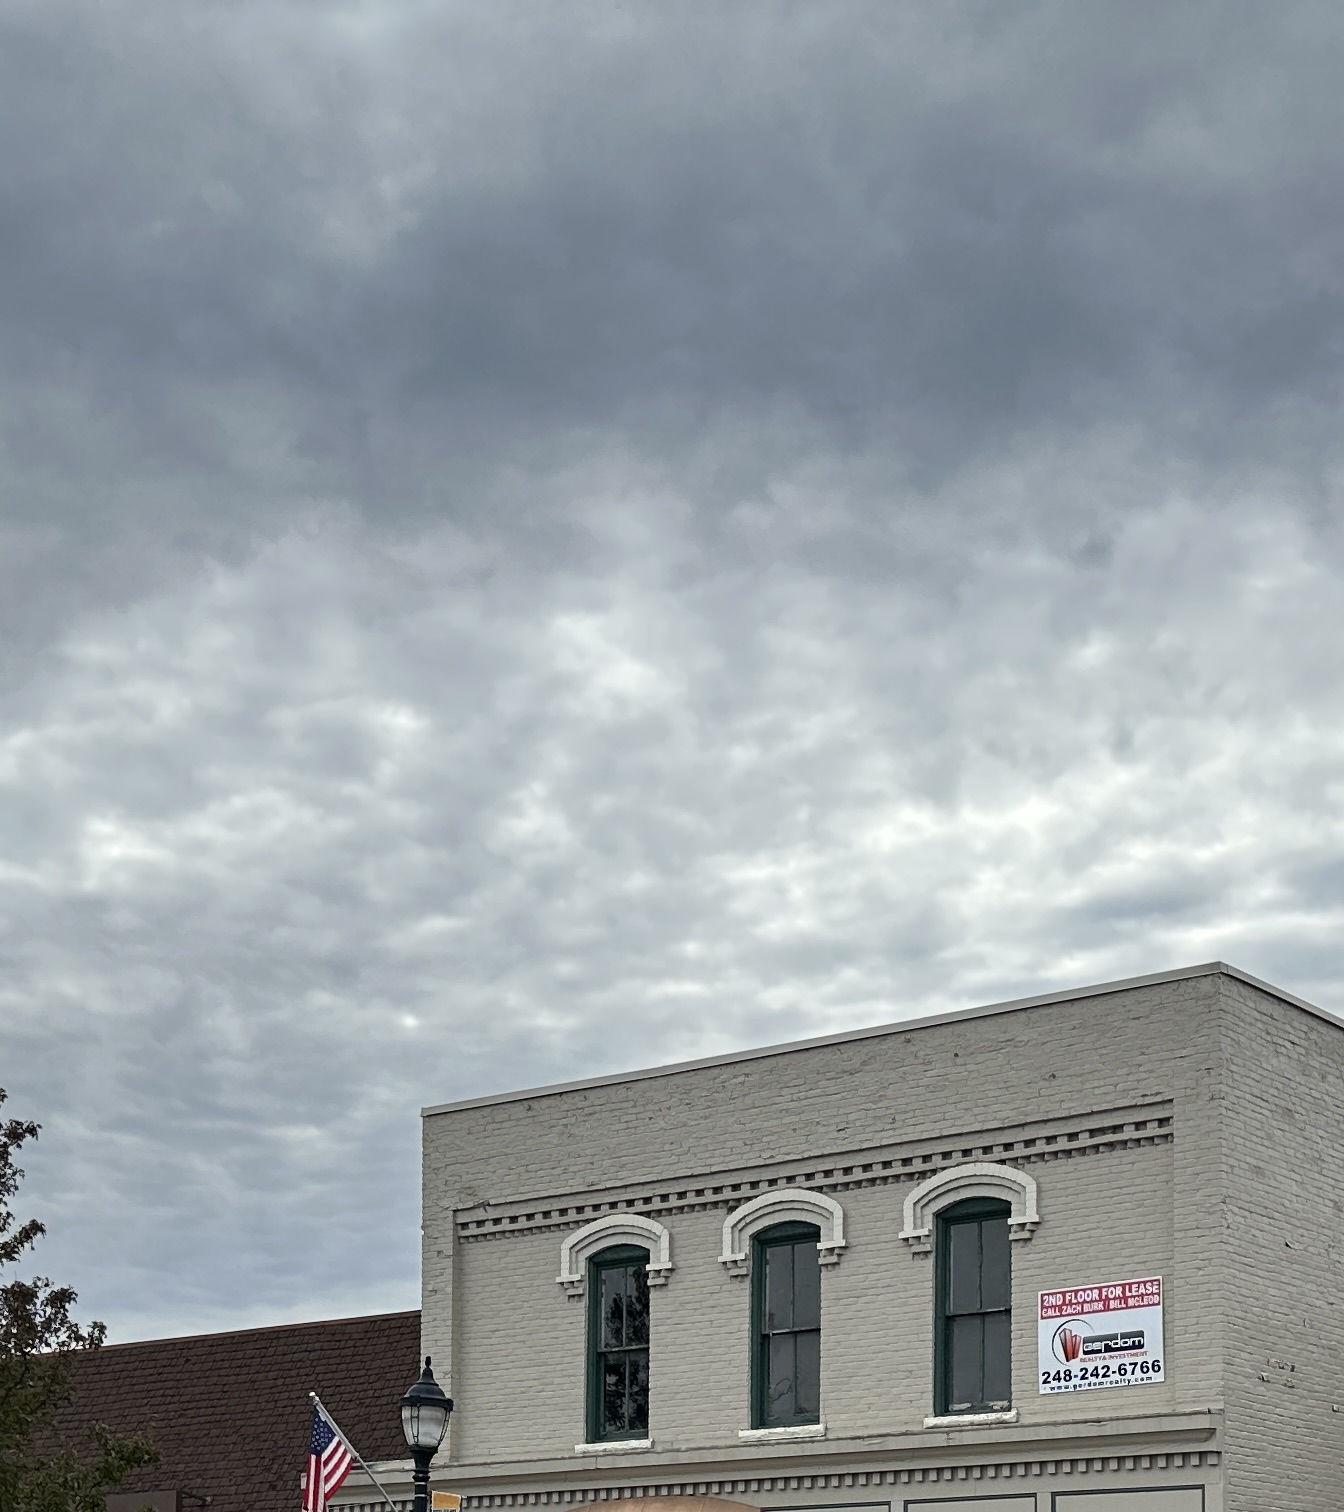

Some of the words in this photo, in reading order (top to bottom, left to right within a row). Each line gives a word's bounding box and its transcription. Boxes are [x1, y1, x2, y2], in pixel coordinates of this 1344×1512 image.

[1042, 1293, 1063, 1306] 2ND
[1066, 1289, 1100, 1304] FLOOR
[1102, 1285, 1123, 1299] FOR
[1125, 1281, 1160, 1296] LEASE
[1042, 1308, 1060, 1317] CALL
[1062, 1305, 1082, 1315] ZACH
[1109, 1299, 1126, 1309] BILL
[1041, 1359, 1161, 1384] 248-242-6766
